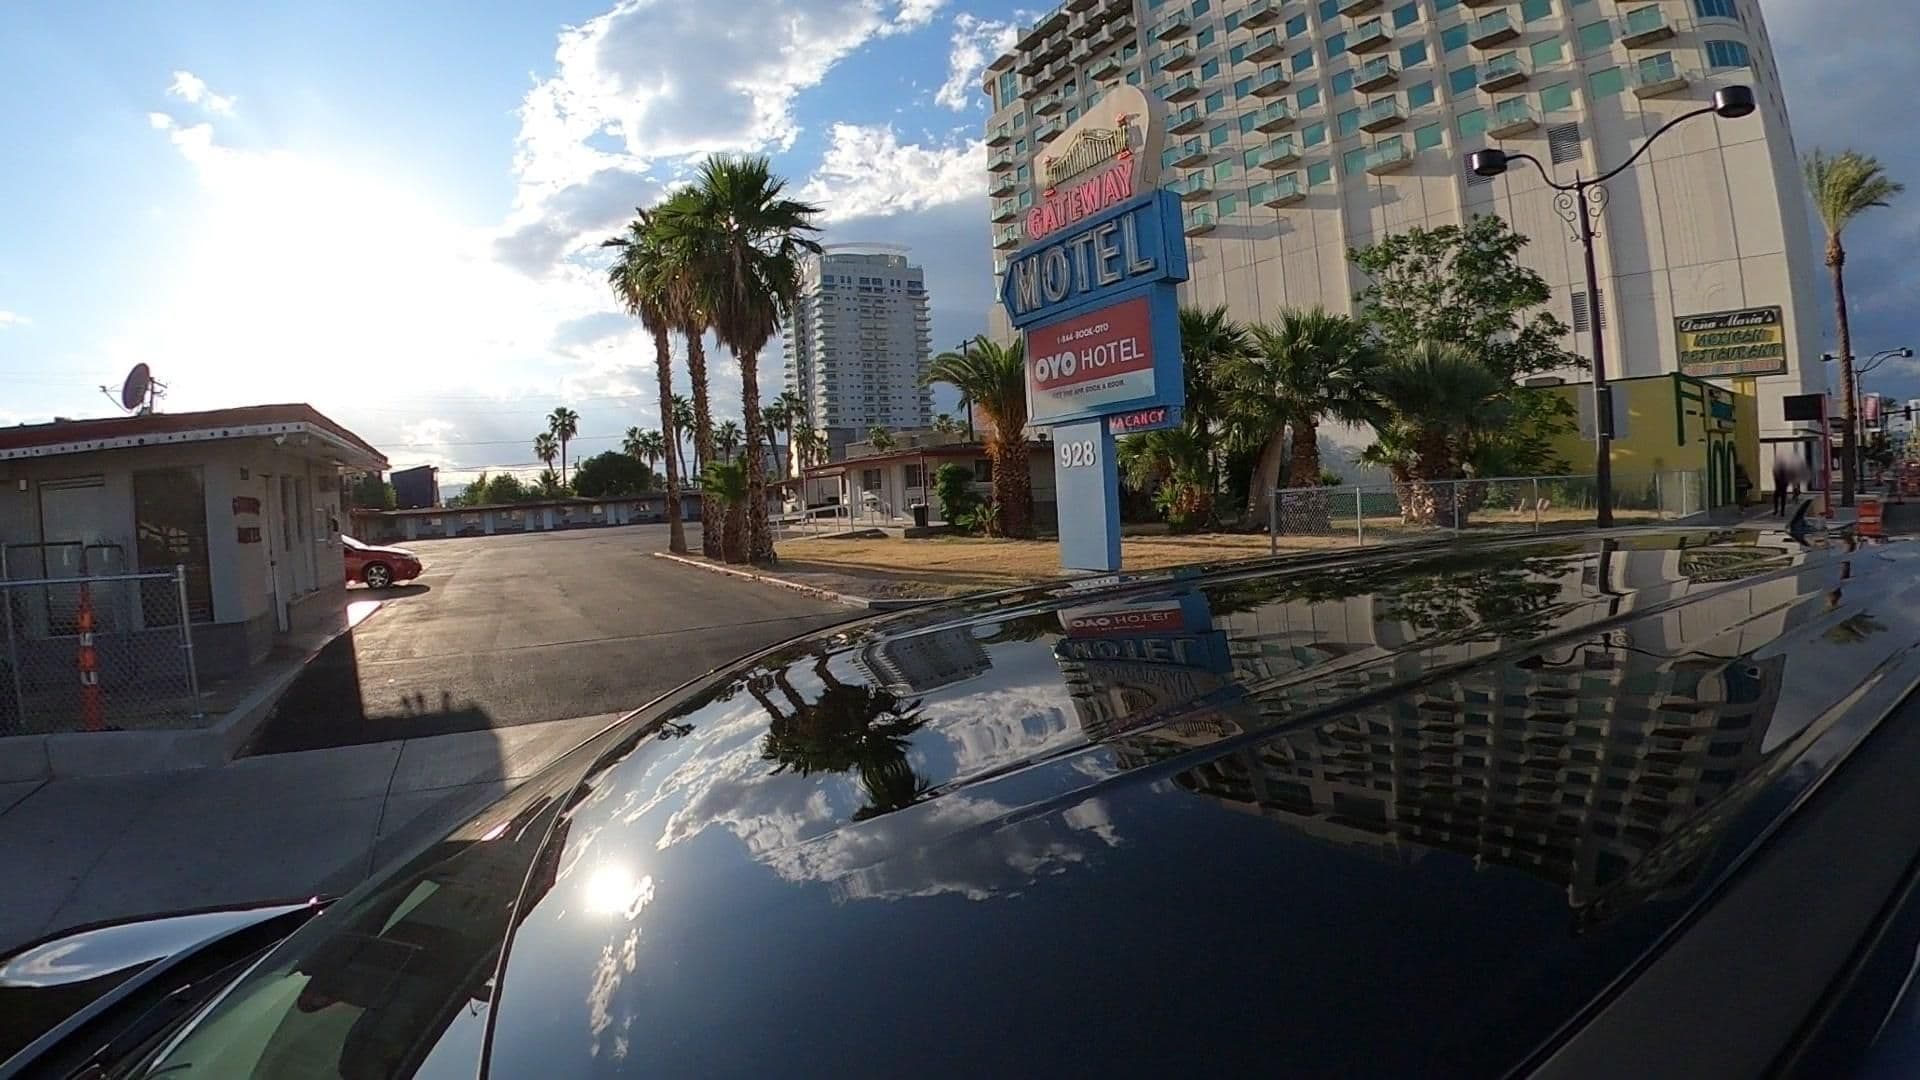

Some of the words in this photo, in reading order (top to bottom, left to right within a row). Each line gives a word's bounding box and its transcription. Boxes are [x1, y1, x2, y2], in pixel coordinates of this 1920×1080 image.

[1026, 158, 1135, 240] GATEWAY
[1013, 211, 1157, 314] MOTEL
[1035, 351, 1077, 382] OYO
[1081, 337, 1144, 370] HOTEL
[1109, 409, 1165, 429] VACANCY
[1061, 439, 1096, 468] 928
